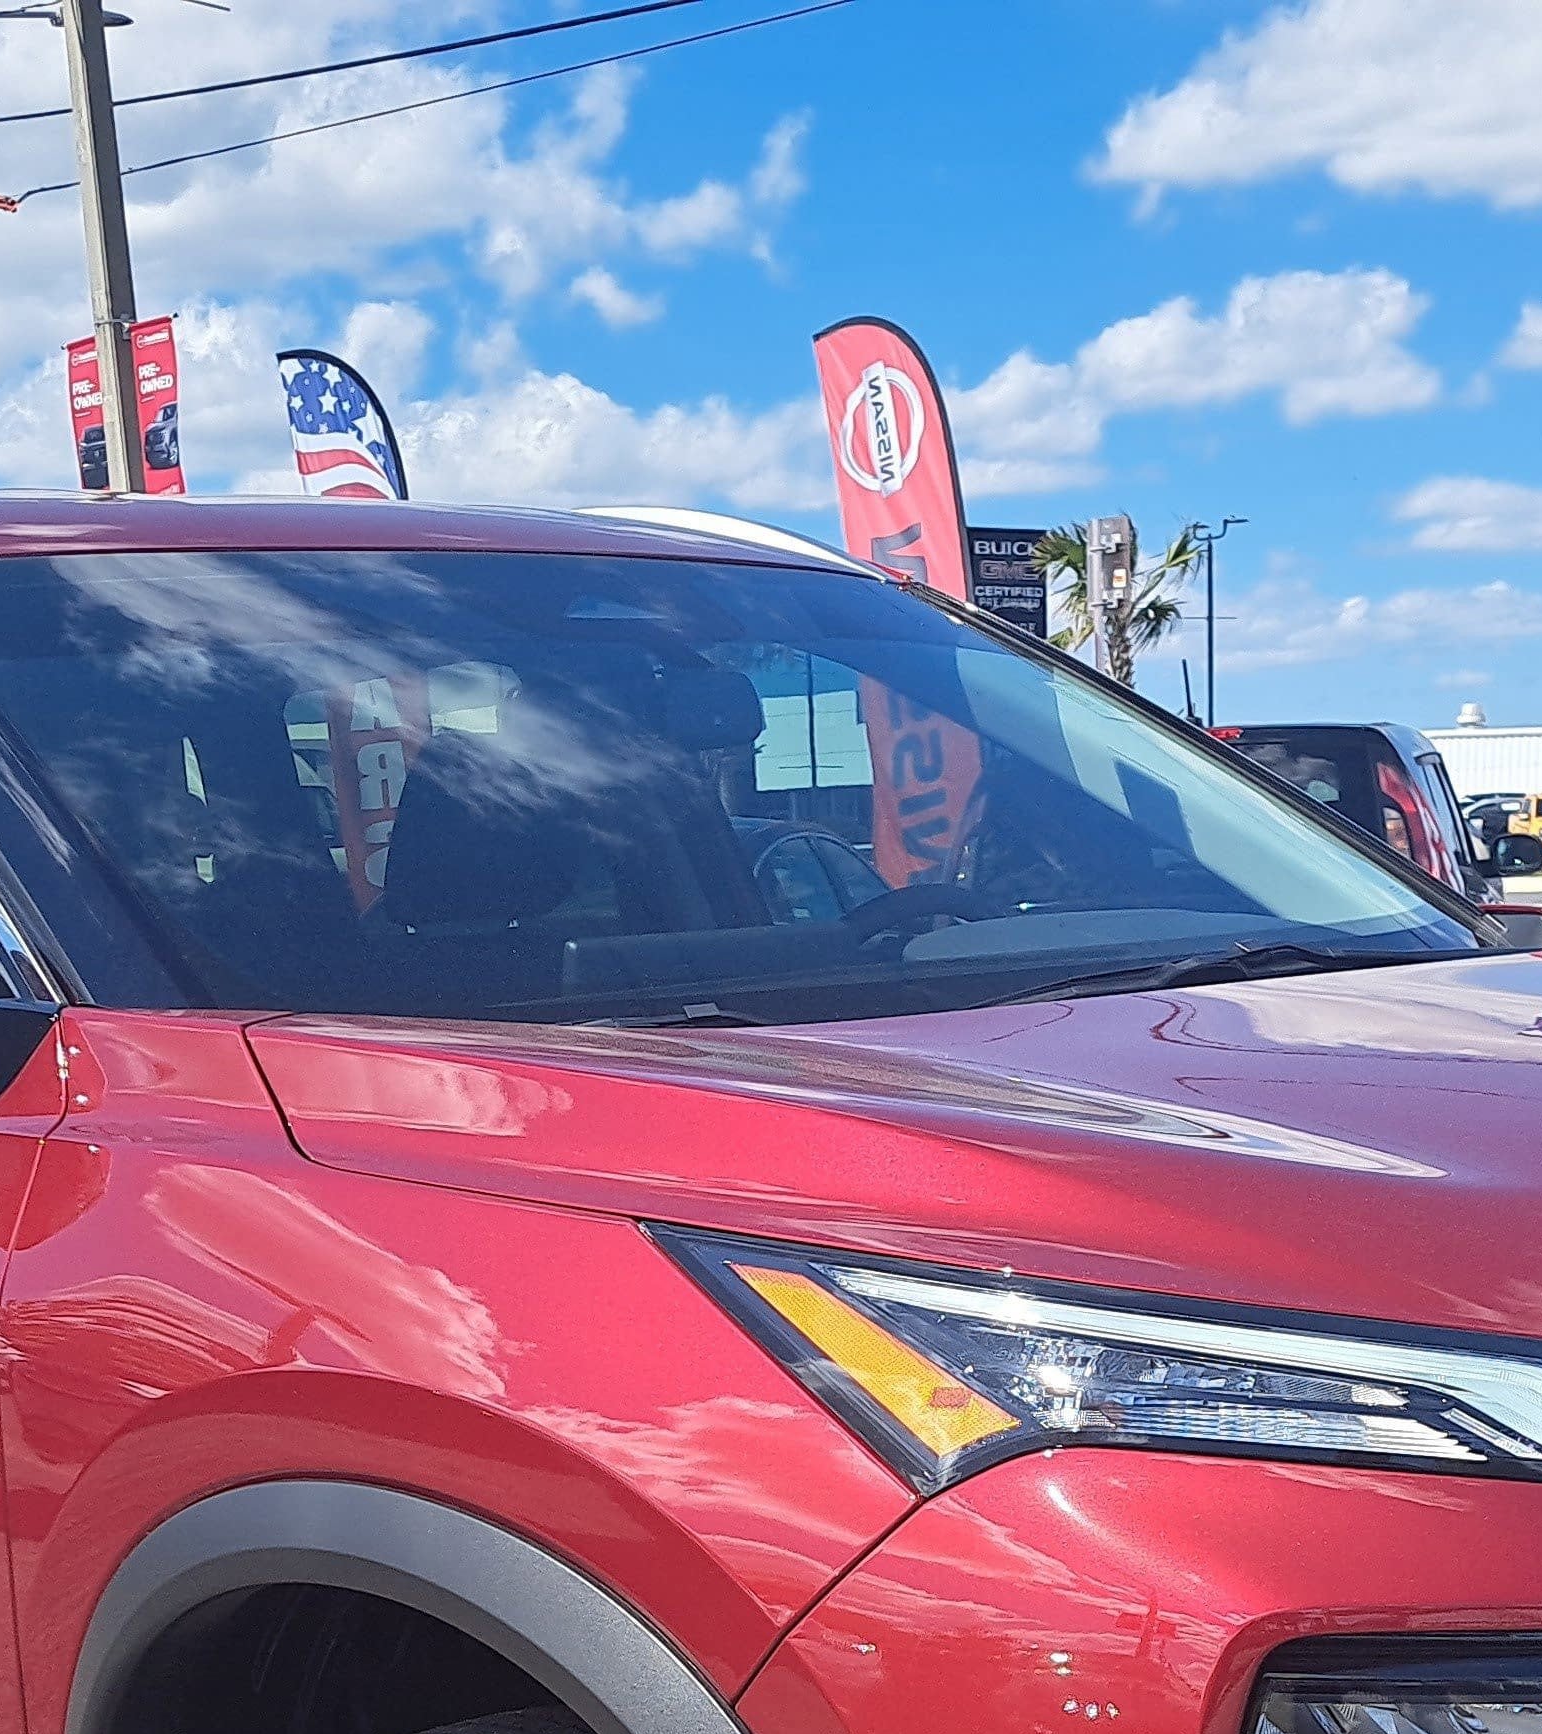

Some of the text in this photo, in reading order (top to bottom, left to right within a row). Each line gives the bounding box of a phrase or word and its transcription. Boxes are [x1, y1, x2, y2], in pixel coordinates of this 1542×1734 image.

[138, 362, 161, 380] PRE-
[140, 373, 174, 395] OWNED
[73, 392, 103, 410] OWNE
[974, 586, 1044, 598] CERTIFIED
